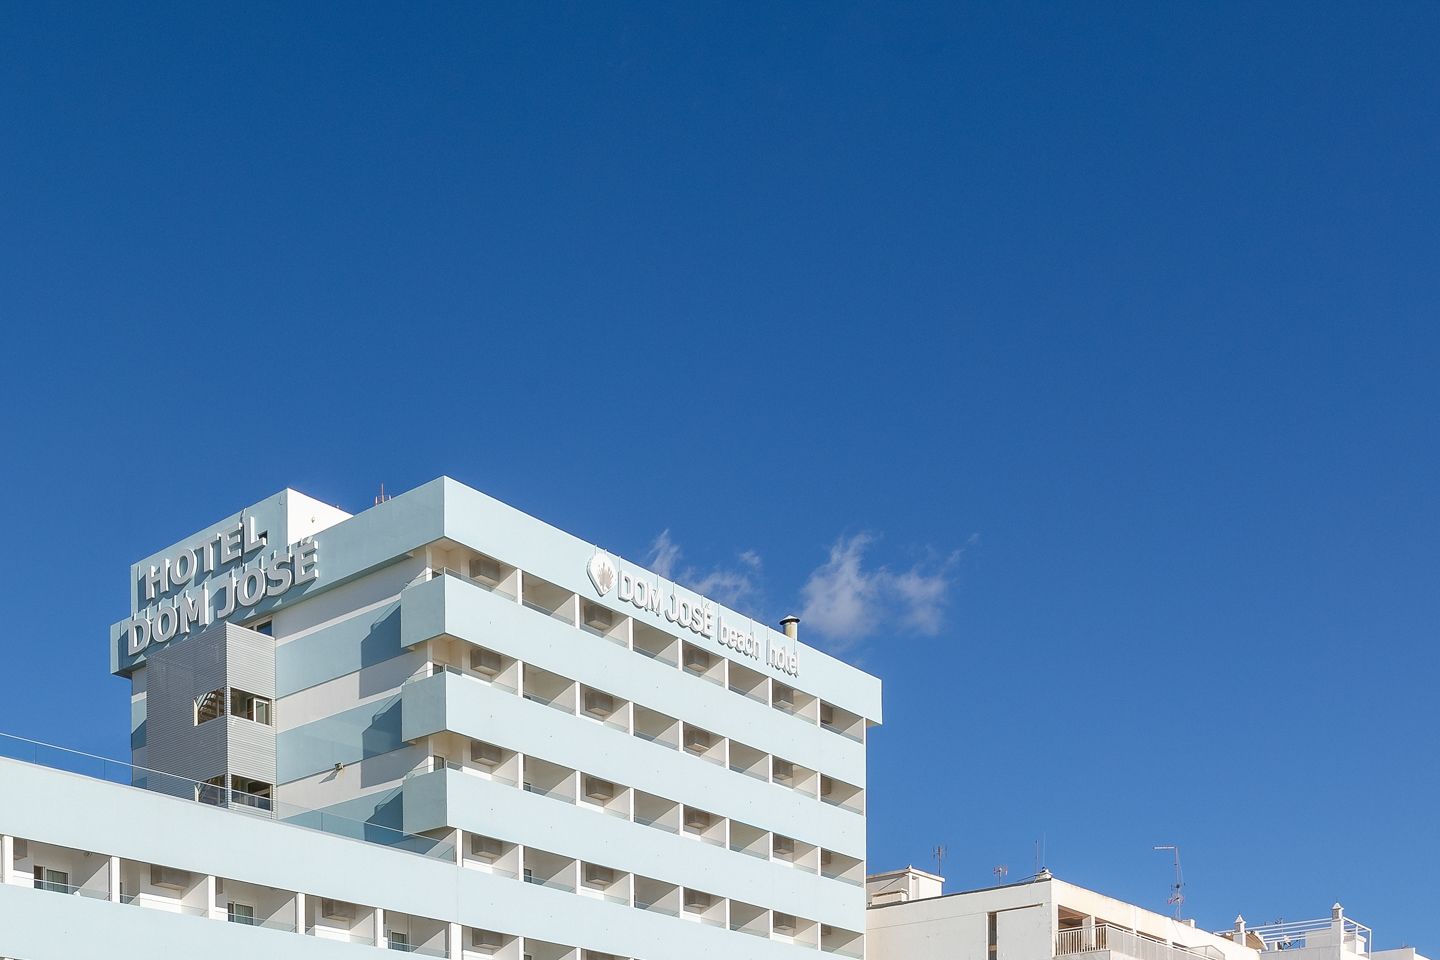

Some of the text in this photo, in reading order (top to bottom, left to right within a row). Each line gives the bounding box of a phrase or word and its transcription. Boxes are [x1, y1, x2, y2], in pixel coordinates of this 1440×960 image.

[128, 536, 319, 656] DOM JOSÉ
[145, 515, 268, 600] HOTEL
[618, 570, 800, 677] DOM JOSÉ beach hotel
